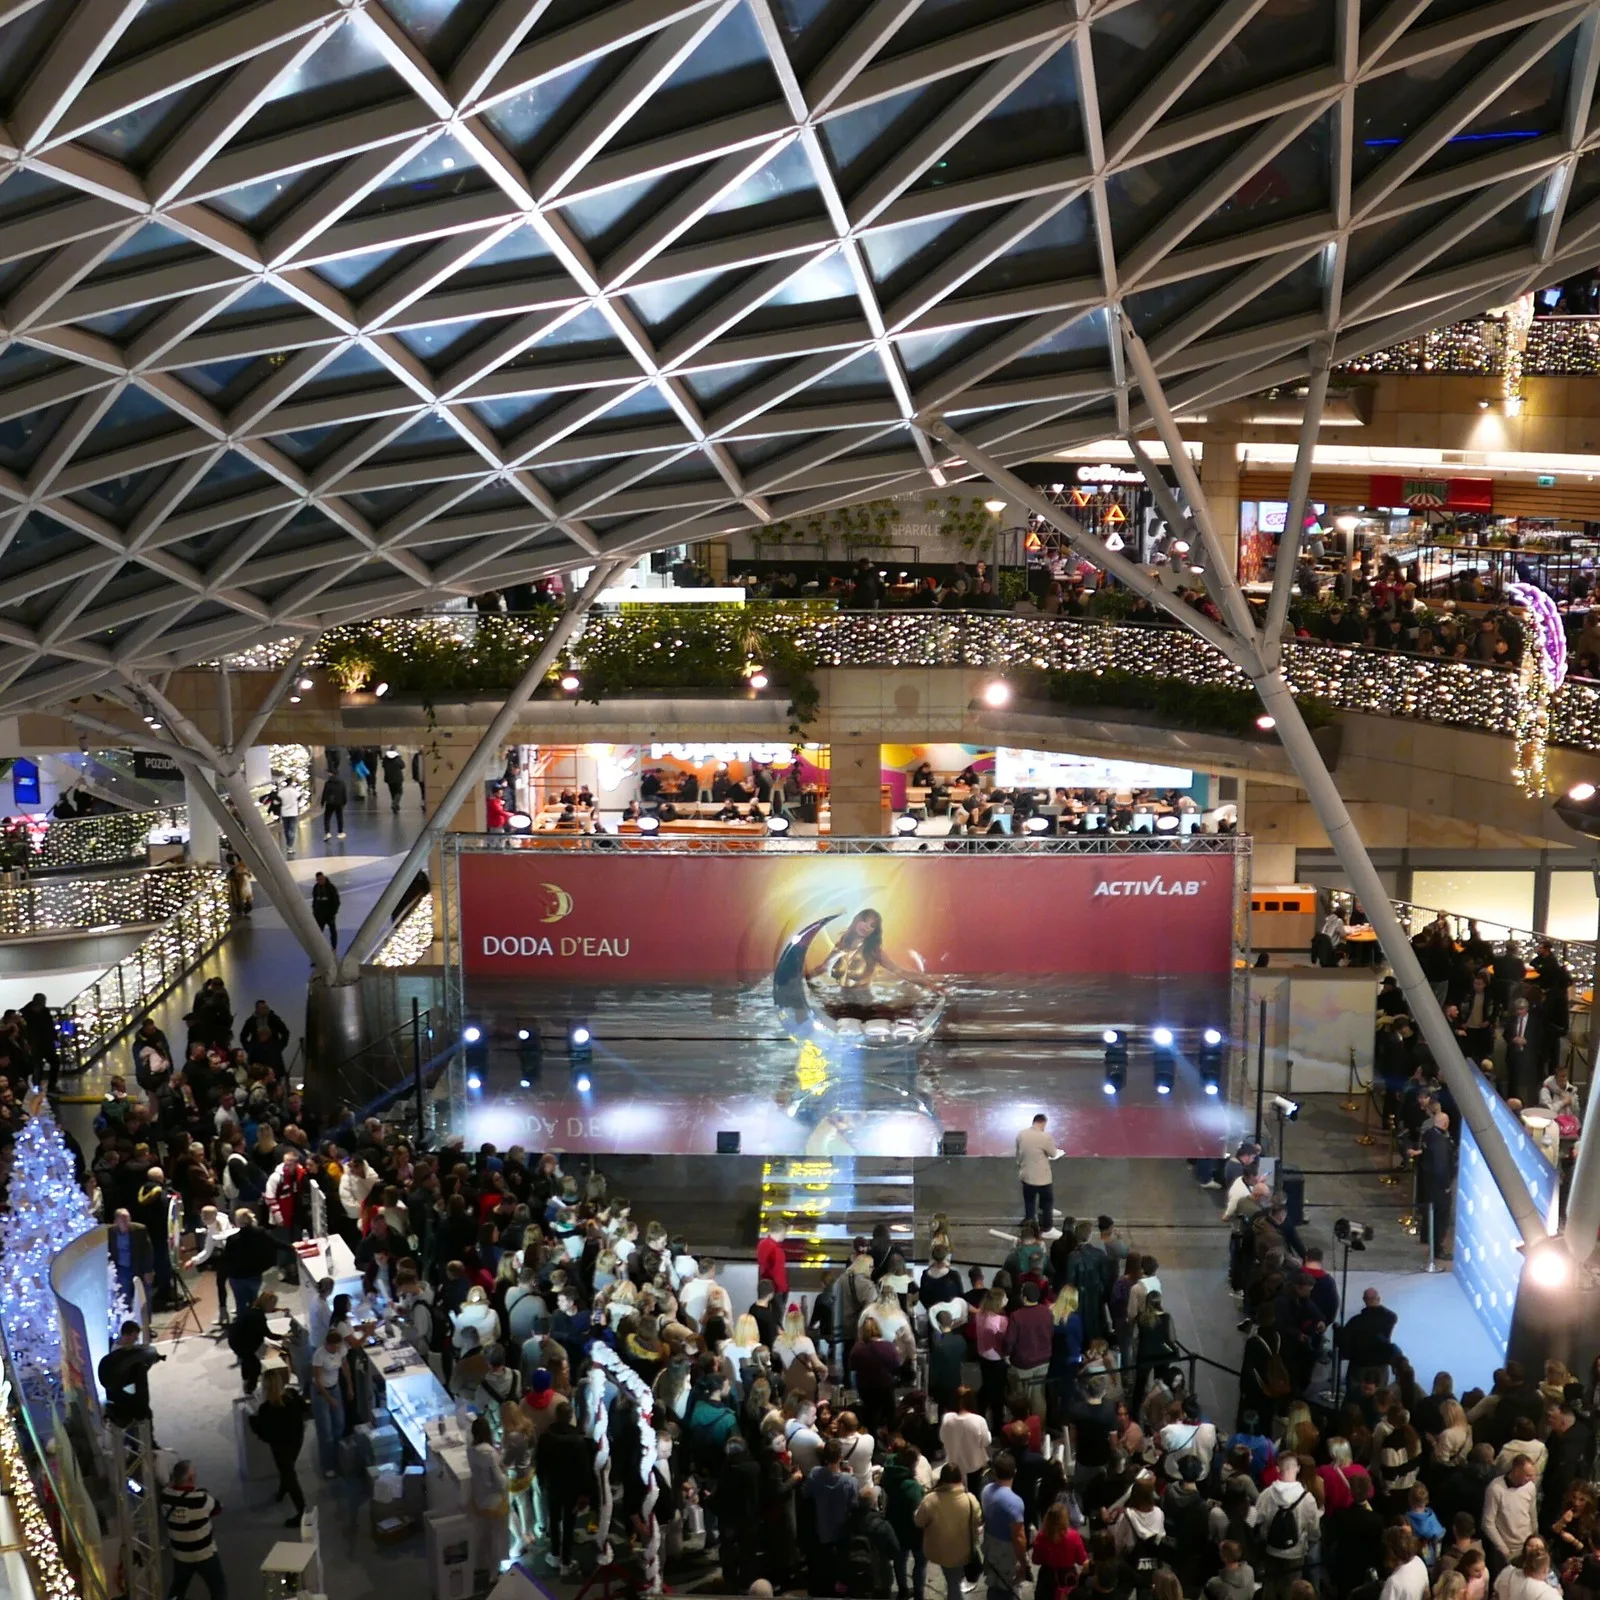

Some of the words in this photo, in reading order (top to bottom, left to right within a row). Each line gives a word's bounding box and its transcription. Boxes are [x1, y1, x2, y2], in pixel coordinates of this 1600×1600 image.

[891, 523, 941, 536] SPARKLE
[483, 936, 554, 956] DODA
[560, 936, 630, 957] D'EAU
